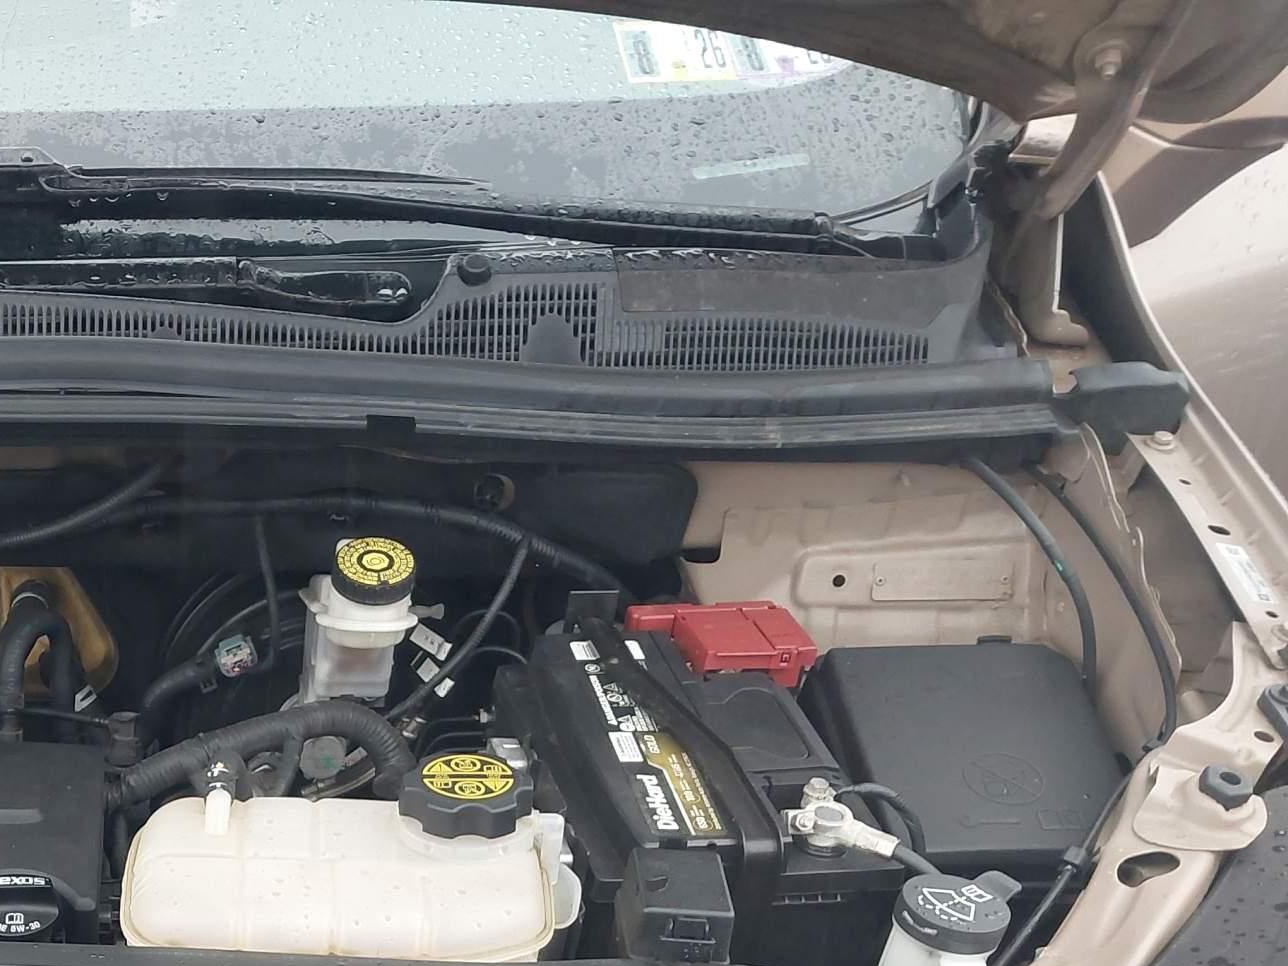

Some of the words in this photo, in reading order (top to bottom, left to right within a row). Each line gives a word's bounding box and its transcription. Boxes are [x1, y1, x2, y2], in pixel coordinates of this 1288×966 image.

[694, 29, 726, 68] 26
[636, 774, 680, 830] DieHard
[10, 921, 41, 933] 5W-30
